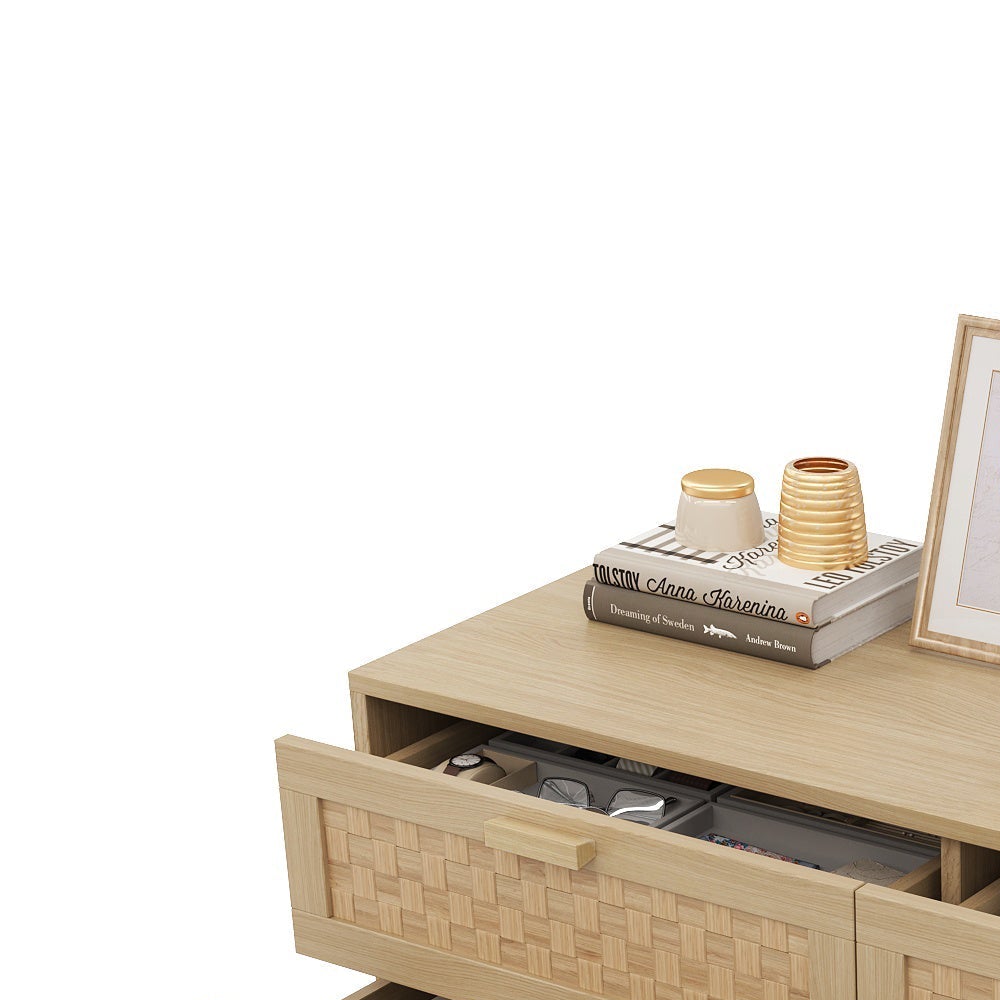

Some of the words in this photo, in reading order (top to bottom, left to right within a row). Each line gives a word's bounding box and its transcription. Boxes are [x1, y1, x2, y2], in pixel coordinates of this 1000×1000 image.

[593, 563, 640, 592] TOLSTOY
[647, 577, 697, 602] Anna
[702, 588, 788, 621] Karenina
[803, 572, 853, 590] LEO
[610, 603, 651, 624] Dreaming
[652, 613, 662, 624] of
[662, 615, 695, 632] Sweden
[746, 633, 773, 647] Andrew
[774, 639, 797, 653] Brown
